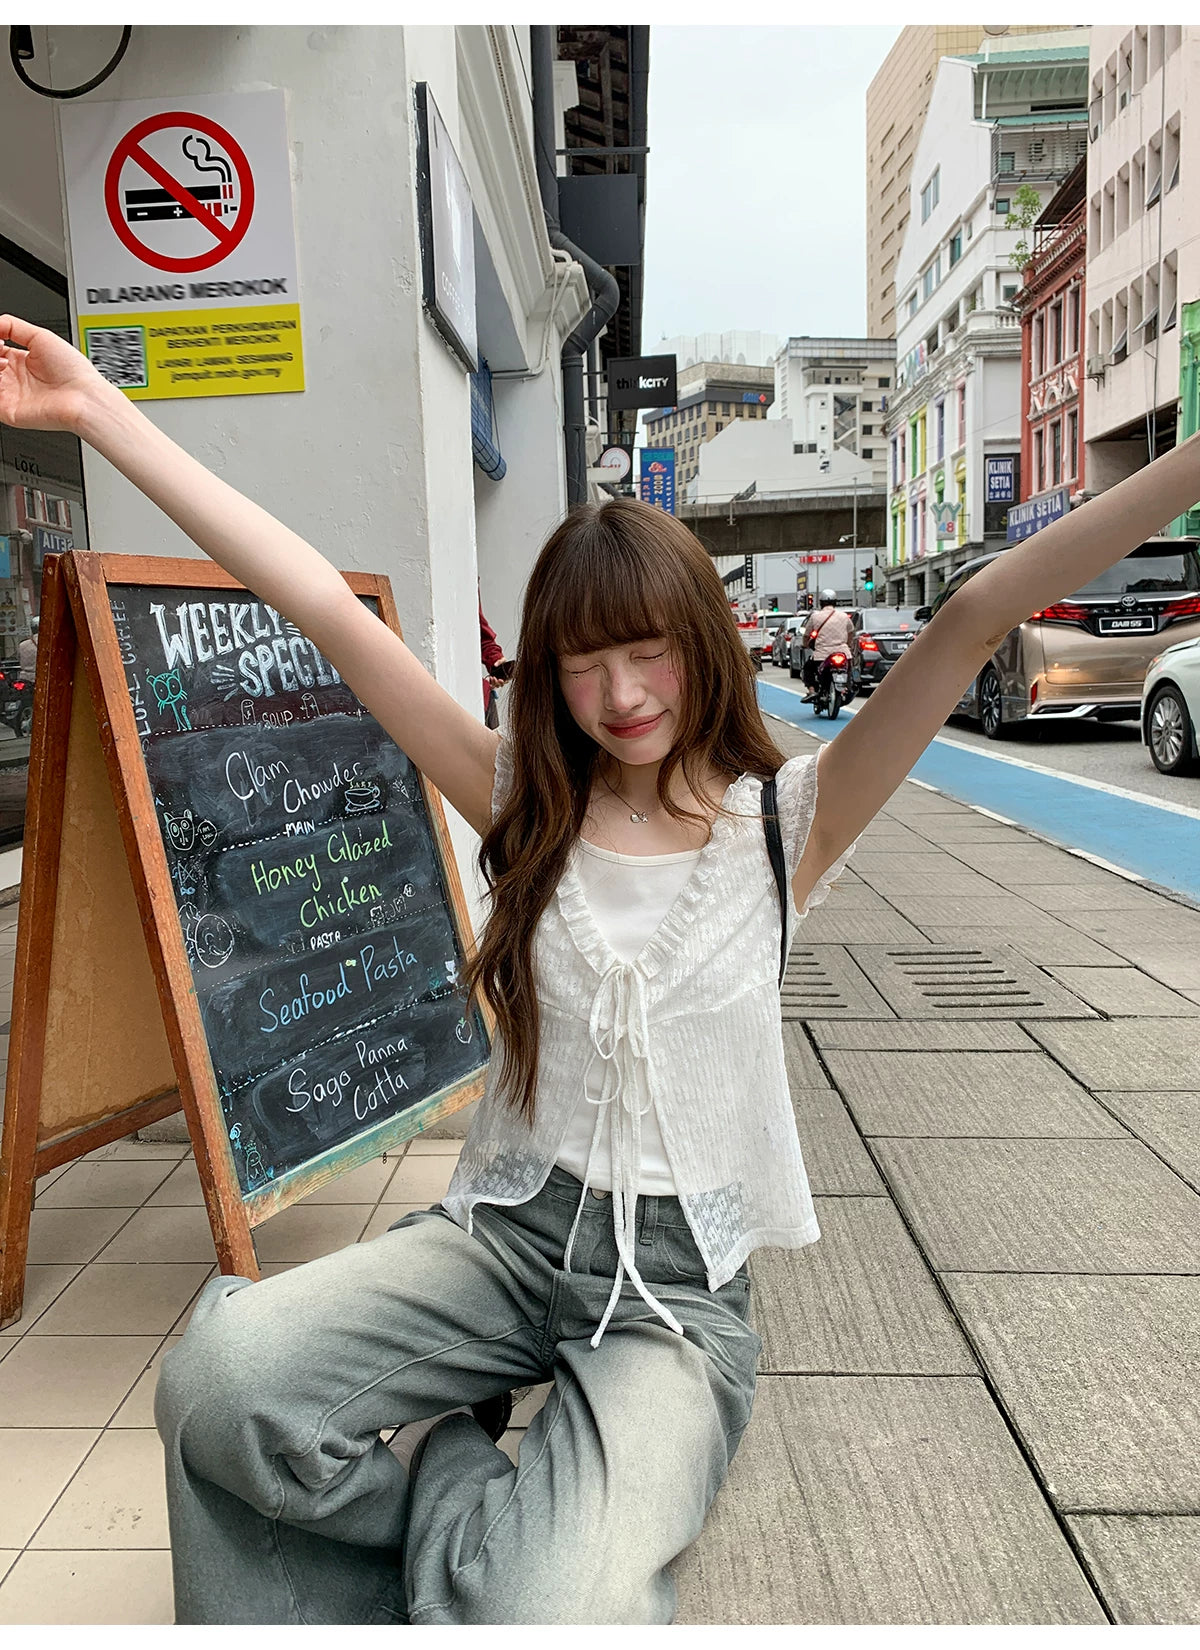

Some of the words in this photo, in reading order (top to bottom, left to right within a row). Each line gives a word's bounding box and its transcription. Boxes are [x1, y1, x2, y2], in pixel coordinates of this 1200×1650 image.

[87, 283, 186, 304] DILARANG
[190, 278, 288, 299] MEROKOK
[988, 461, 1012, 474] KLINIK
[990, 476, 1010, 489] SETIA
[931, 502, 962, 522] YY
[938, 521, 955, 533] 48
[1009, 505, 1035, 527] KLINIK
[1036, 494, 1062, 518] SETIA
[150, 602, 285, 671] WEEKLY
[238, 637, 342, 698] SPECI
[262, 710, 294, 729] SOUP
[225, 751, 290, 801] Clam
[285, 820, 316, 837] MAIN
[251, 852, 319, 895] Honey
[327, 820, 394, 866] Glazed
[299, 875, 383, 929] Chicken
[310, 930, 341, 951] PASTA
[259, 961, 351, 1033] Seafood
[359, 935, 419, 992] Pasta
[285, 1067, 352, 1113] Sago
[355, 1035, 409, 1067] Panna
[353, 1065, 409, 1121] Cotta
